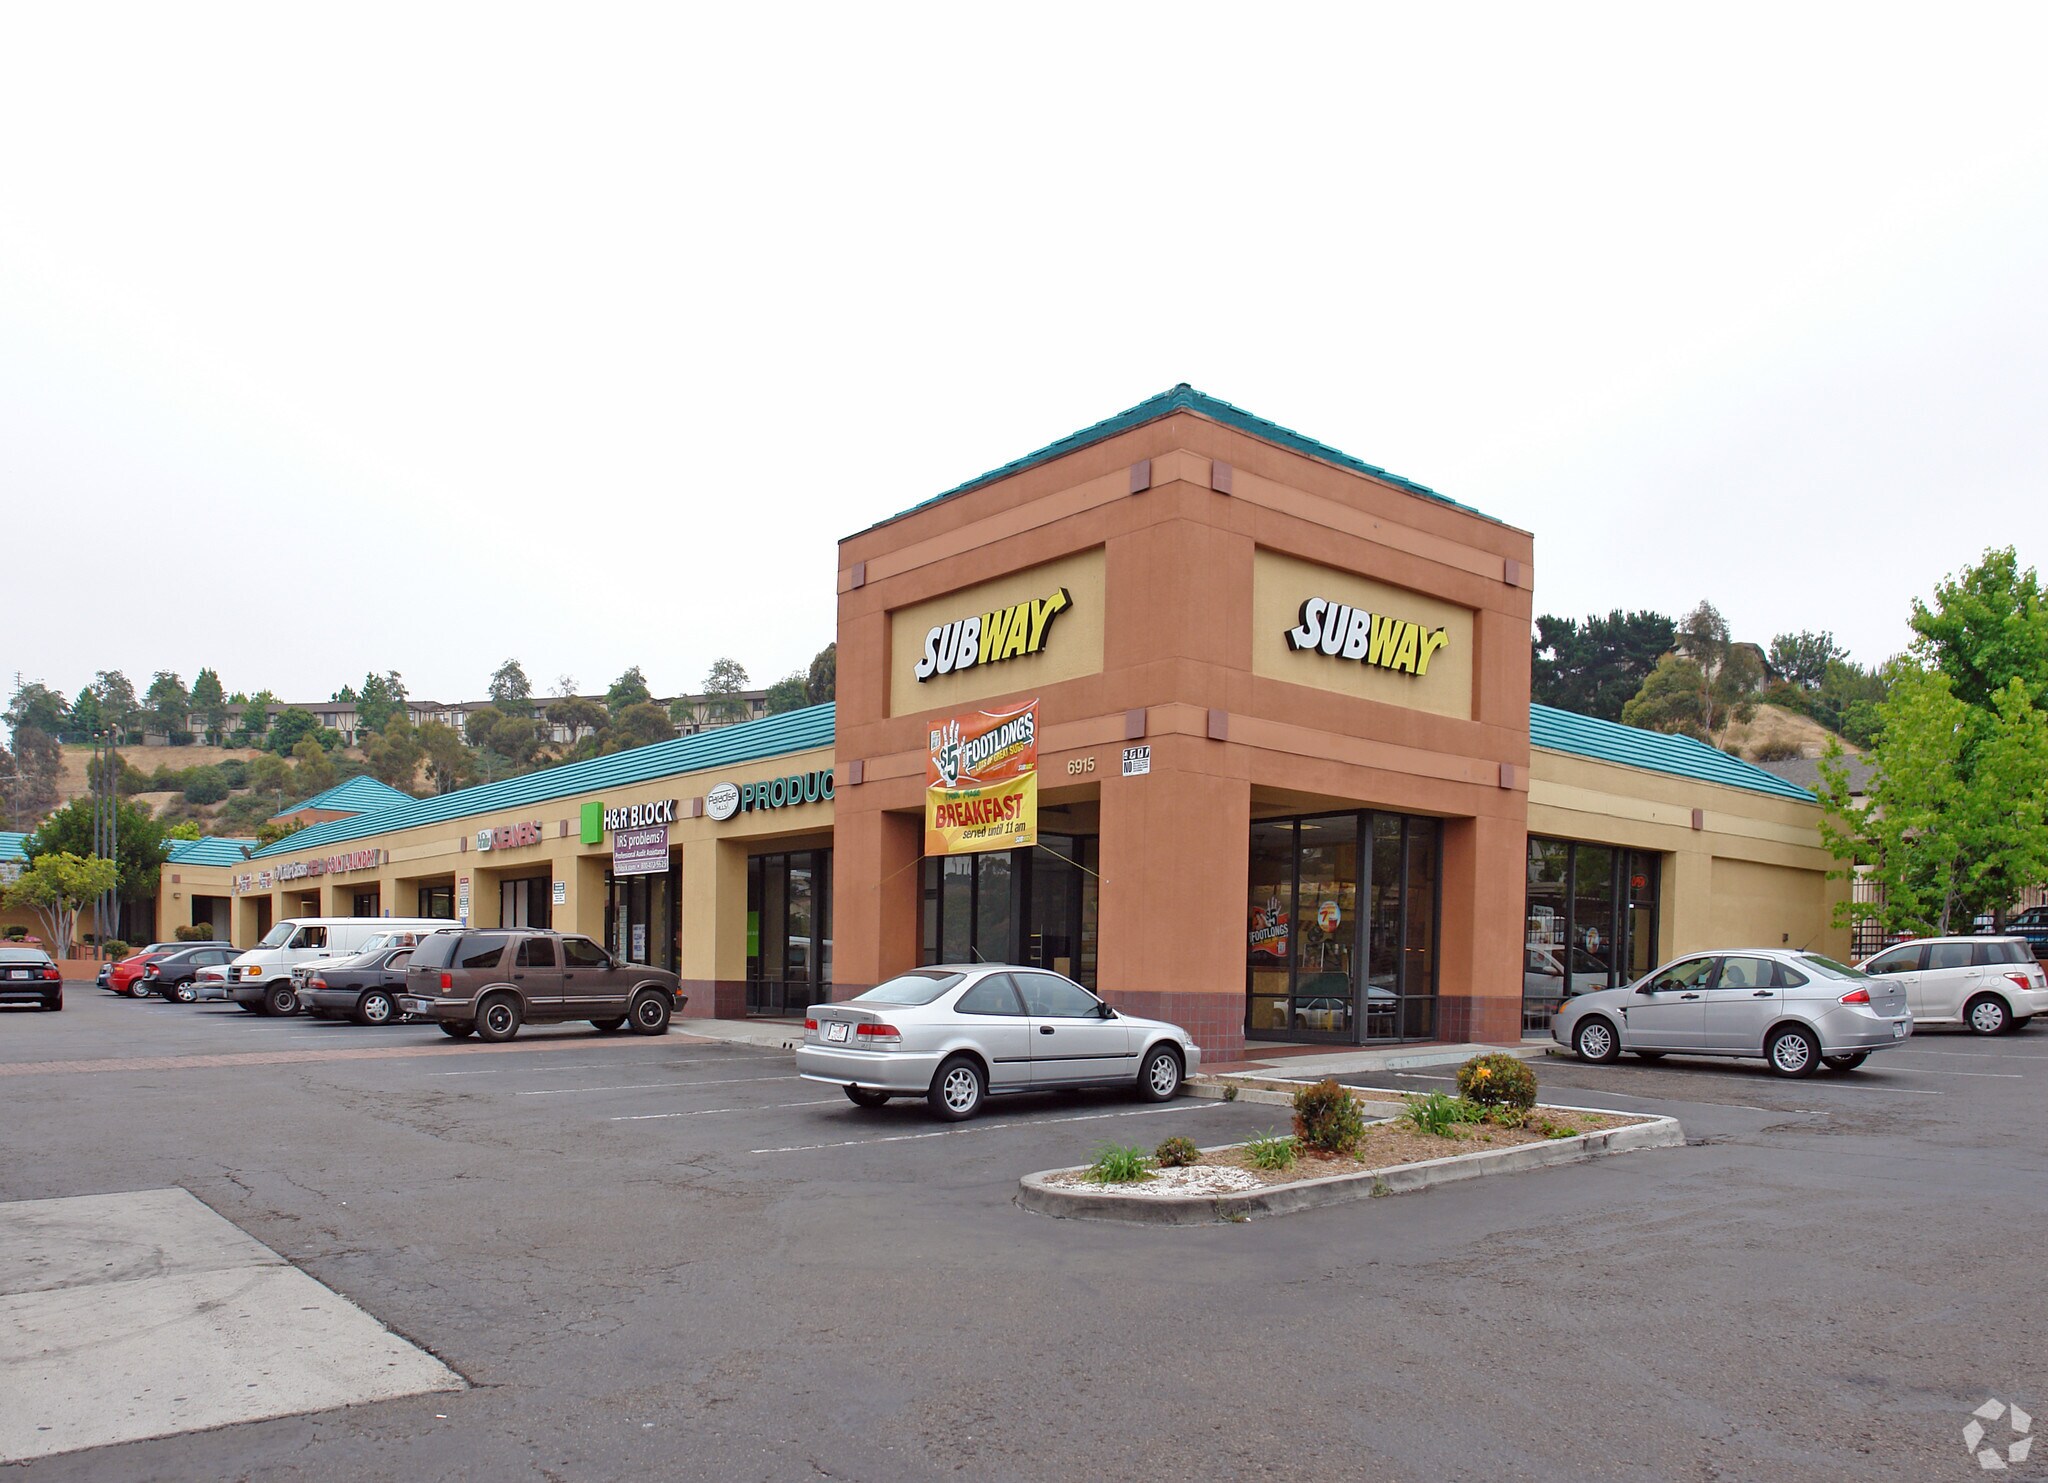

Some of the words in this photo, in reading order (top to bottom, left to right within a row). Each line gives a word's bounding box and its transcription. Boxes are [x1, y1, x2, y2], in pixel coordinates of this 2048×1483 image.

[914, 587, 1070, 682] SUBWAY
[1288, 597, 1449, 675] SUBWAY
[965, 712, 1034, 764] FOOTLONGS
[993, 747, 1008, 762] GREAT
[1009, 741, 1025, 755] SUBS
[1067, 756, 1095, 775] 6915
[708, 792, 736, 805] Paradise
[603, 807, 629, 831] H&R
[630, 799, 674, 827] BLOCK
[935, 793, 1023, 828] BREAKFAST
[492, 820, 541, 849] CLEANERS
[616, 834, 628, 848] IRS
[628, 829, 665, 849] problems?
[962, 826, 986, 839] served
[988, 825, 1003, 836] until
[1005, 821, 1013, 834] 11
[1014, 822, 1026, 832] am
[344, 849, 379, 872] LAUNDRY
[1251, 923, 1288, 941] FOOTLONGS
